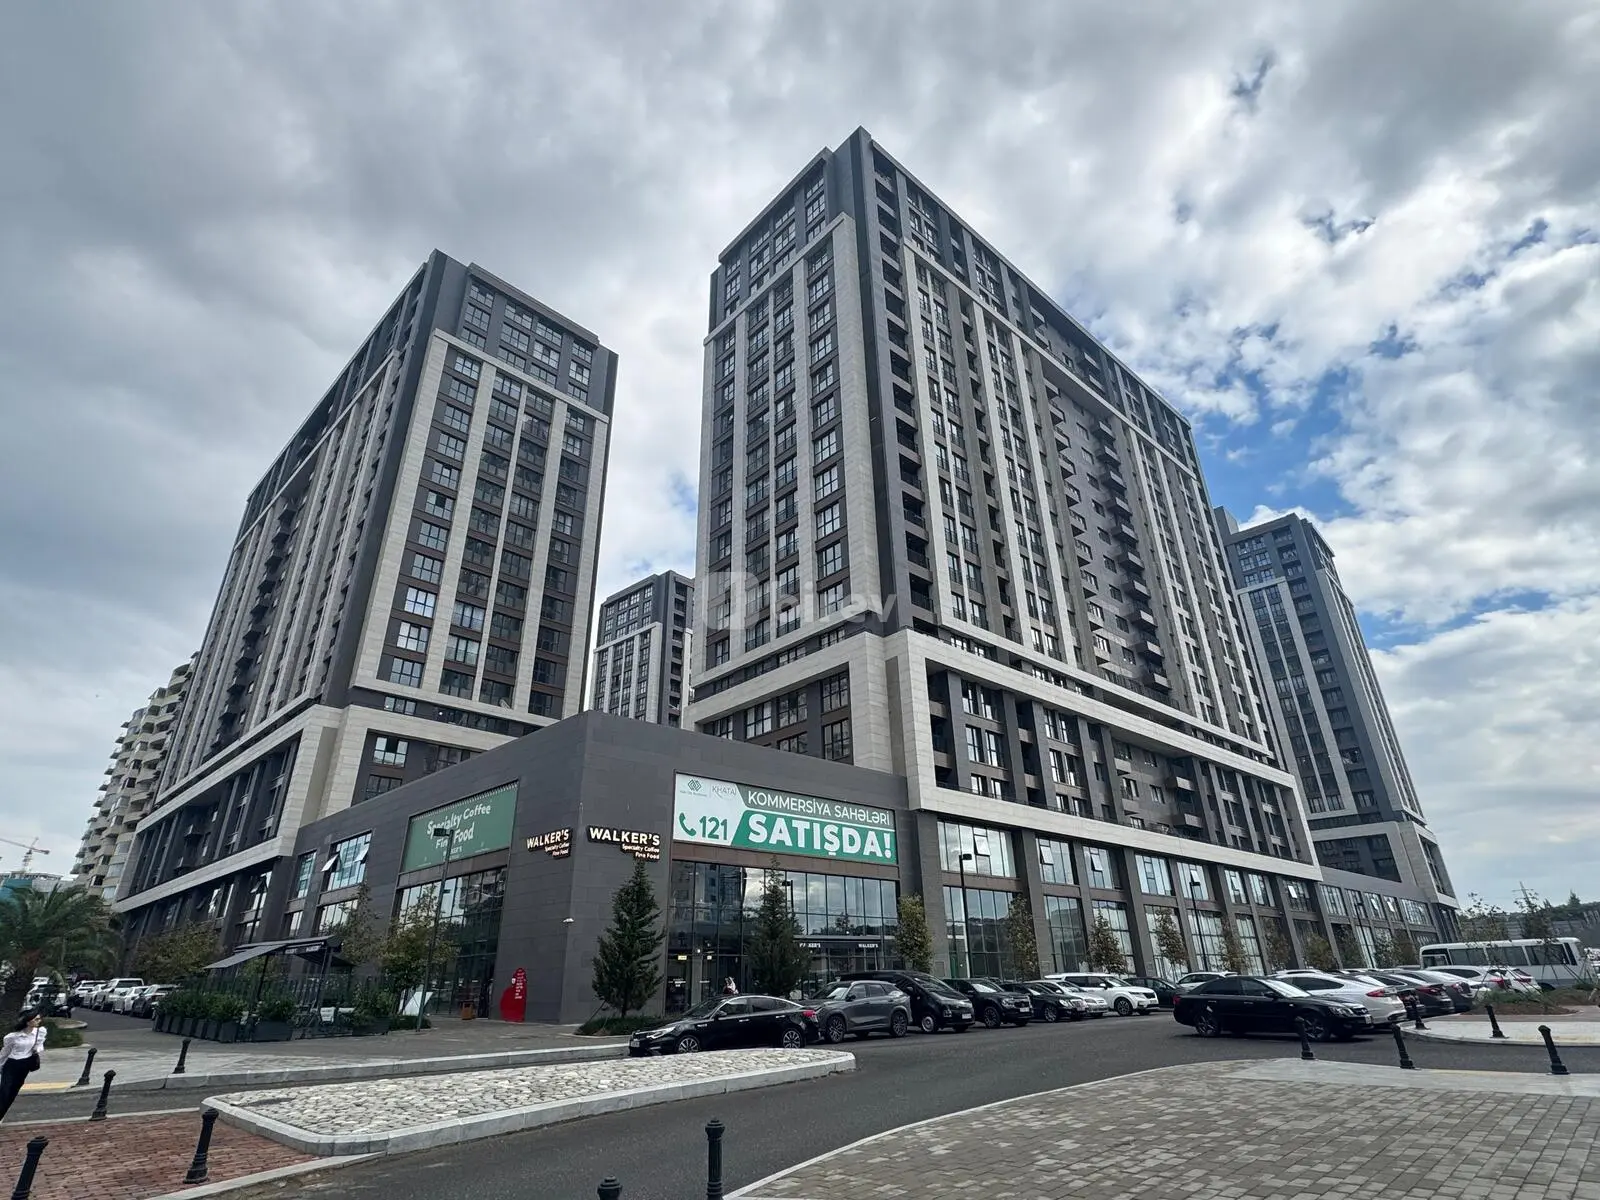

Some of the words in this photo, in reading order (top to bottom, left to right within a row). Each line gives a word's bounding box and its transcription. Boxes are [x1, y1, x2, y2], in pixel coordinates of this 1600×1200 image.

[463, 803, 491, 820] Coffee
[748, 790, 832, 816] KOMMERSİYA
[834, 804, 890, 826] SAHƏLƏRİ
[453, 822, 475, 843] Food
[590, 827, 660, 846] WALKER'S
[699, 815, 728, 841] 121
[748, 814, 892, 859] SATIŞDA!
[526, 829, 569, 848] WALKER'S
[647, 852, 660, 860] Food
